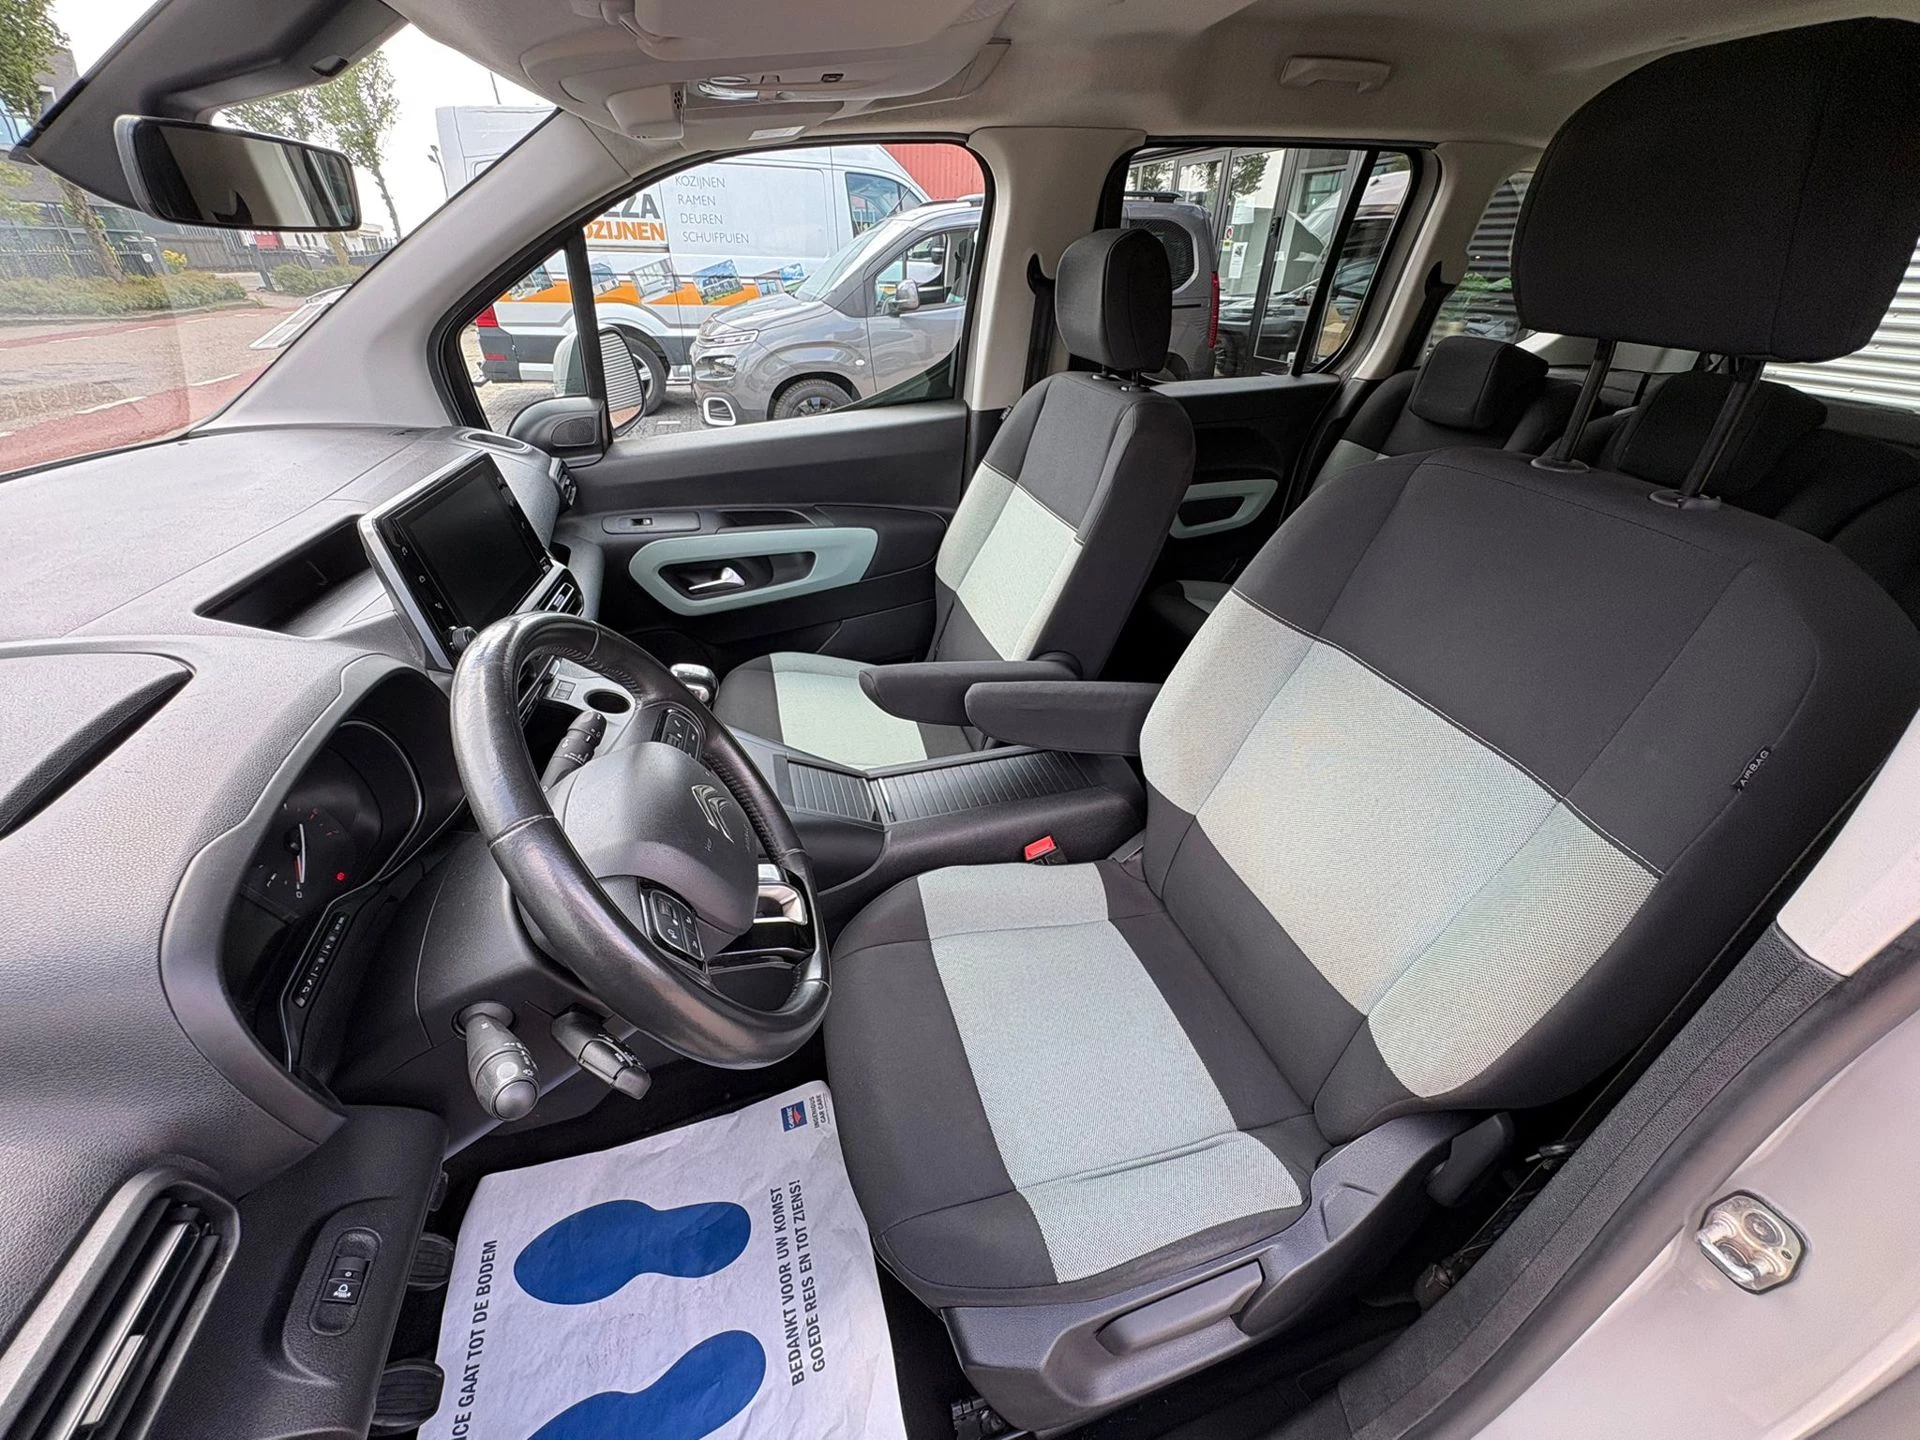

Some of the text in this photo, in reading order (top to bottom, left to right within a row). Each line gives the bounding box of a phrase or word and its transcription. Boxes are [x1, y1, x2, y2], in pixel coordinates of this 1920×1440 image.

[675, 175, 725, 189] KOZIJNEN
[678, 195, 716, 206] RAMEN
[680, 213, 723, 225] DEUREN
[682, 232, 749, 244] SCHUIFPUIEN
[1740, 750, 1769, 787] AIRBAG
[476, 1240, 498, 1296] BODEM
[788, 1180, 826, 1372] GOEDE REIS EN TOT ZIENS!
[770, 1187, 805, 1386] BEDANKT VOOR UW KOMST
[472, 1299, 489, 1324] DE
[466, 1329, 486, 1360] TOT
[458, 1363, 480, 1407] GAAT
